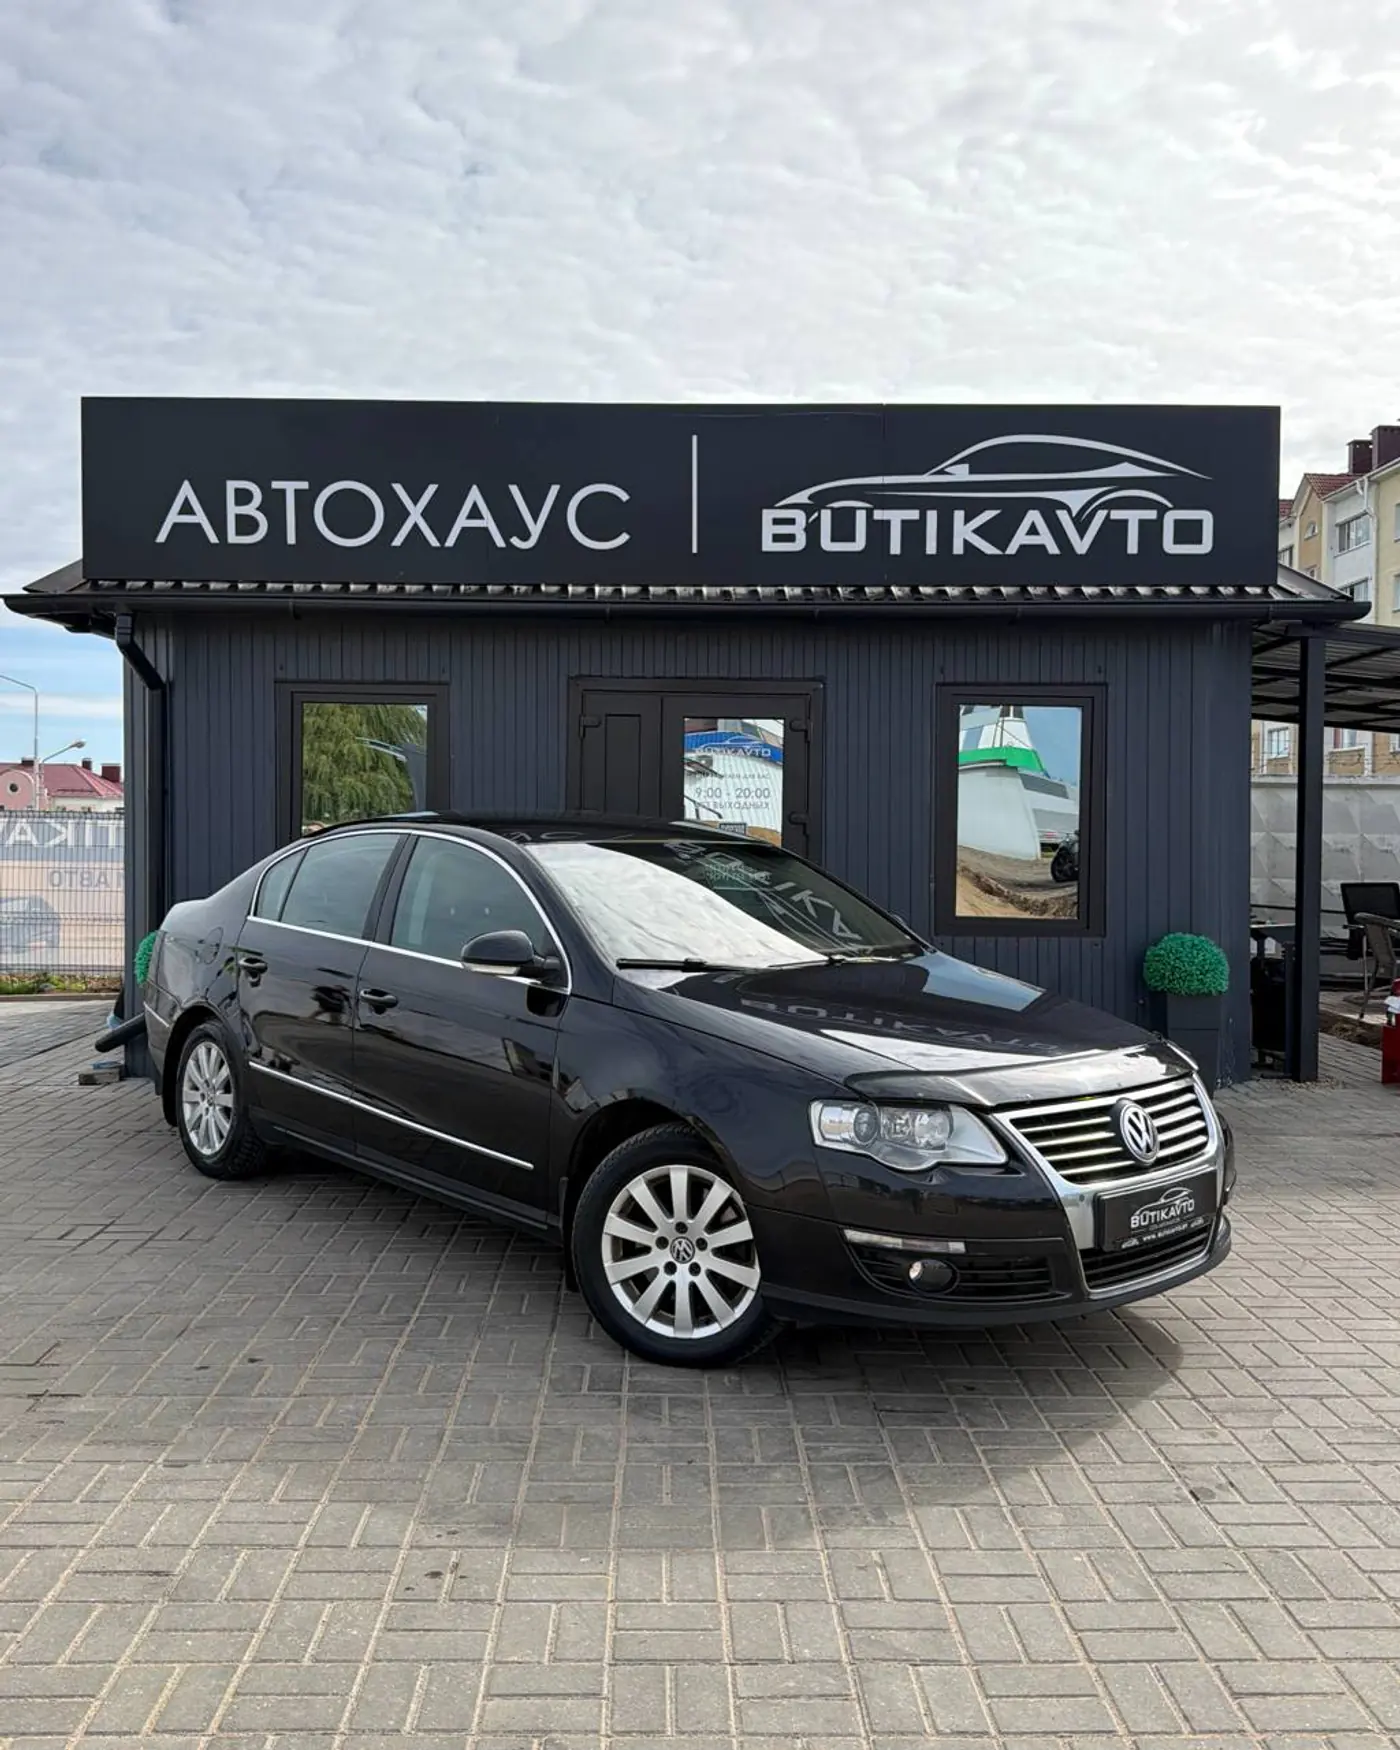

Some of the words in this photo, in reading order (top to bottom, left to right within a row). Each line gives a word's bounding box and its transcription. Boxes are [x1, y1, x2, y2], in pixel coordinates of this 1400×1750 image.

[156, 479, 632, 551] АВТОХАУС
[761, 507, 1214, 556] BUTIKAVTO
[735, 787, 771, 799] 20:00
[1130, 1199, 1195, 1229] BUTIKAVTO
